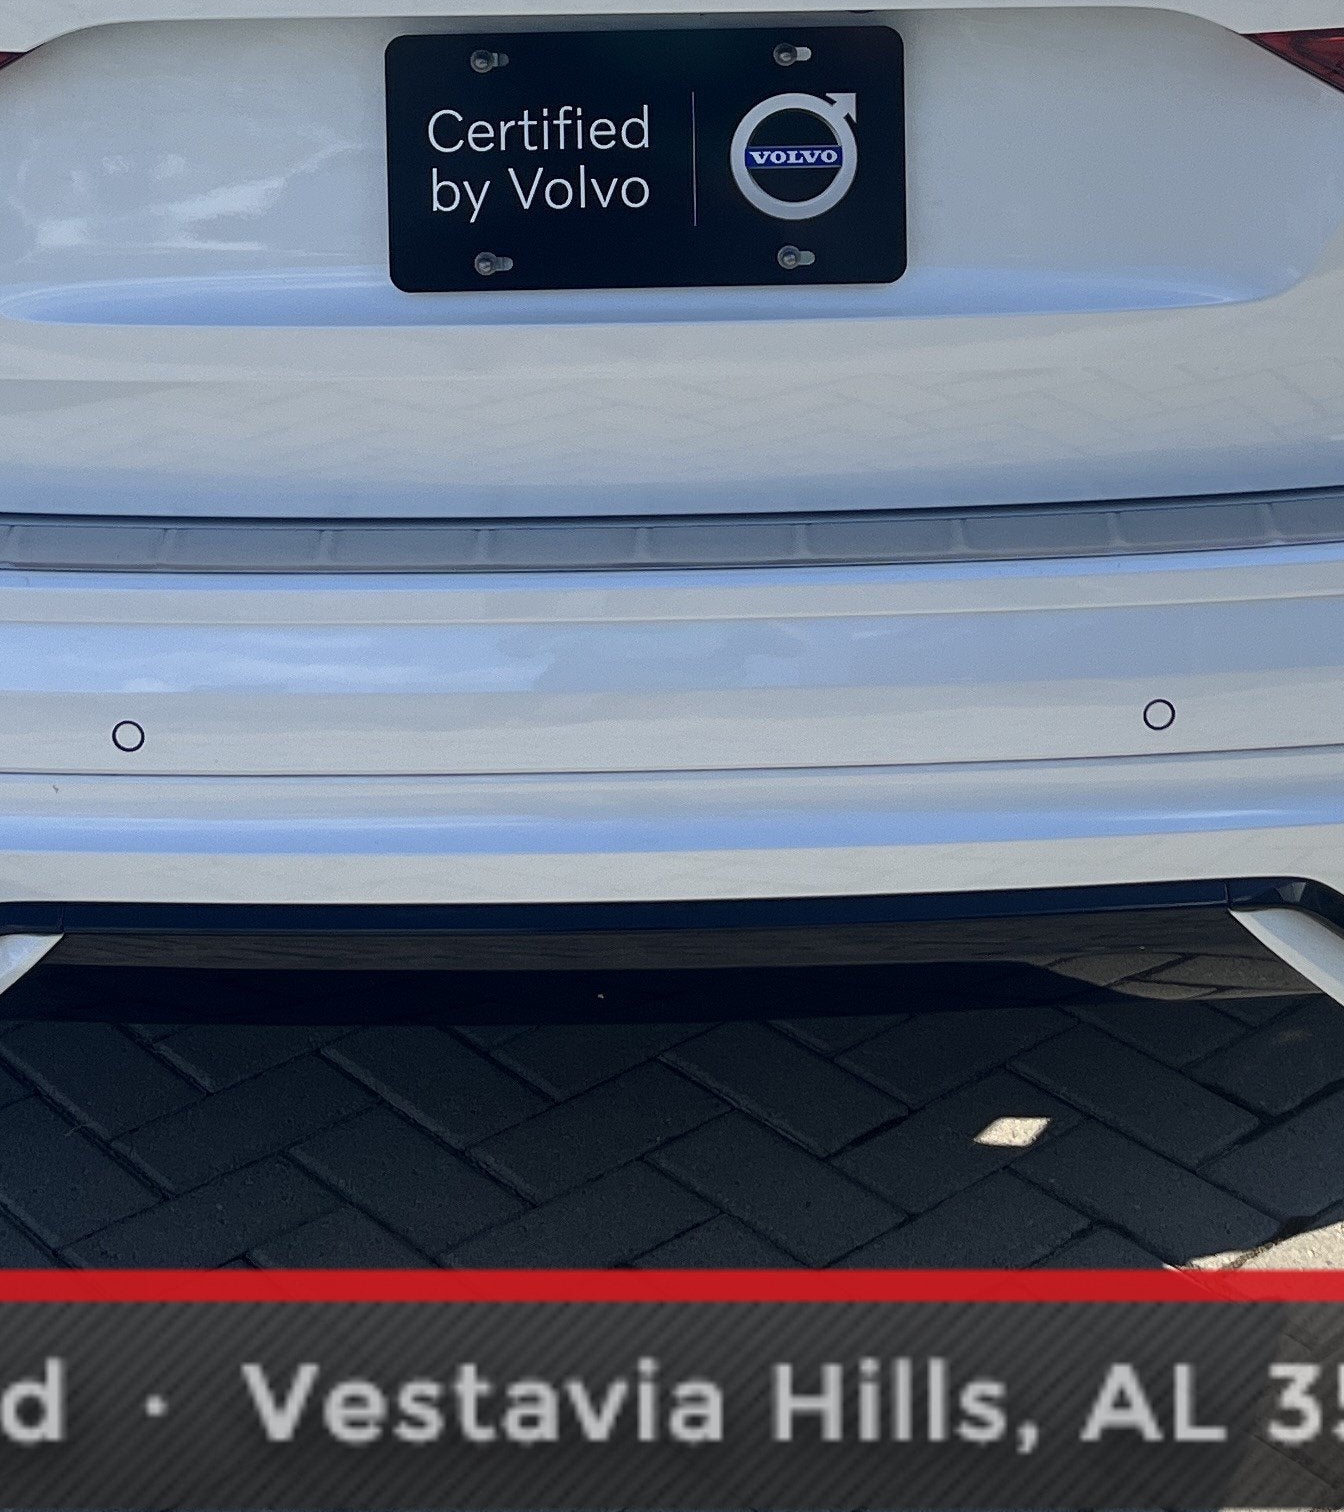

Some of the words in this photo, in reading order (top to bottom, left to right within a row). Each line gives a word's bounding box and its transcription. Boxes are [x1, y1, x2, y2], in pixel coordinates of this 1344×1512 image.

[427, 103, 650, 153] Certified
[749, 148, 839, 165] VOLVO
[430, 167, 492, 224] by
[507, 164, 651, 210] Volvo
